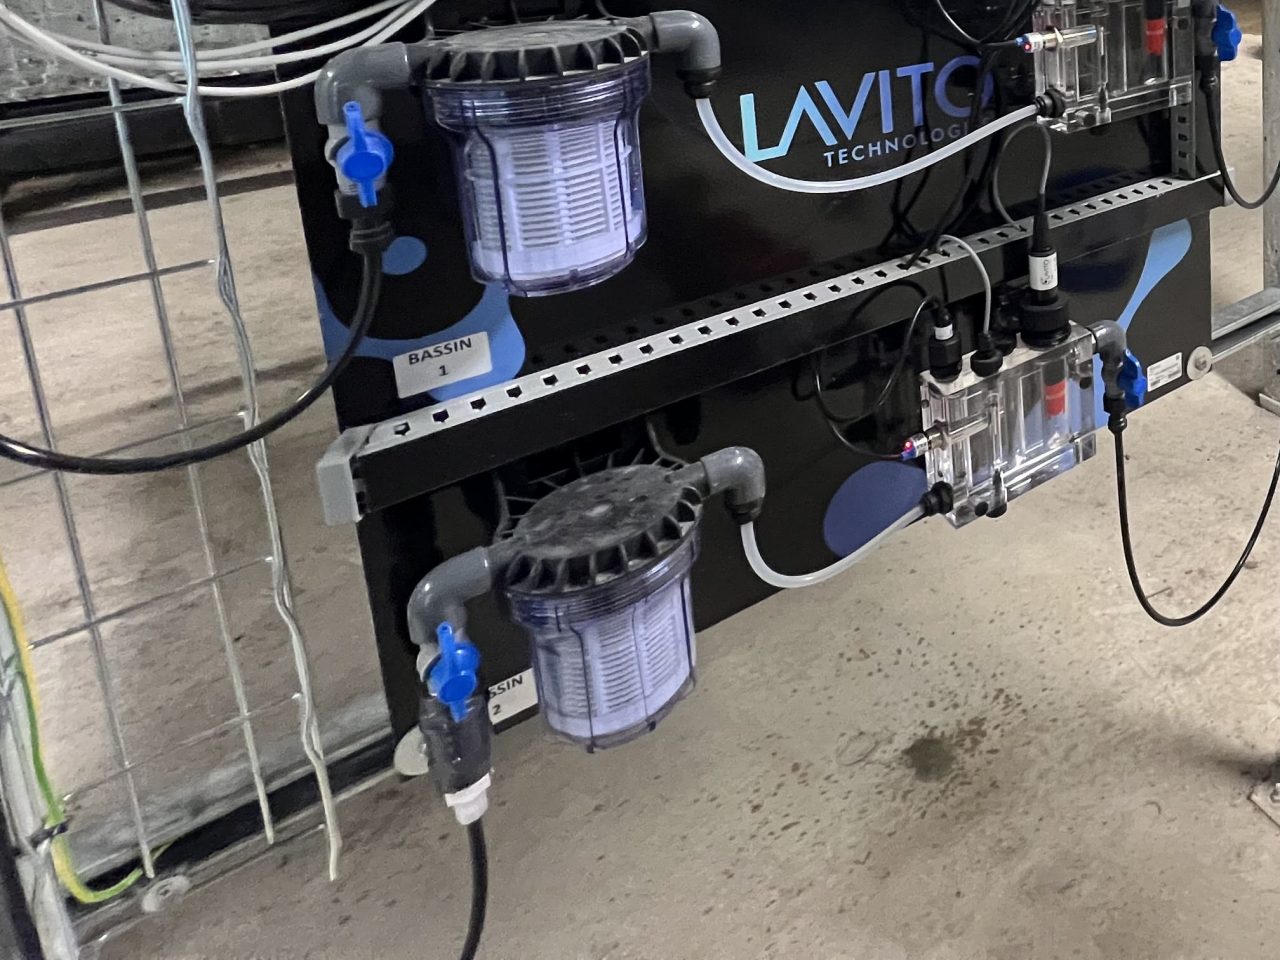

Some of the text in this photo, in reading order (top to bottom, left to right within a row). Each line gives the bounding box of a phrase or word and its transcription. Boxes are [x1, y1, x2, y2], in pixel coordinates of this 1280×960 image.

[823, 119, 993, 168] TECHNOLOGI
[408, 337, 472, 366] BASSIN
[438, 365, 449, 377] 1
[489, 674, 524, 699] SSIN
[492, 704, 502, 716] 2
